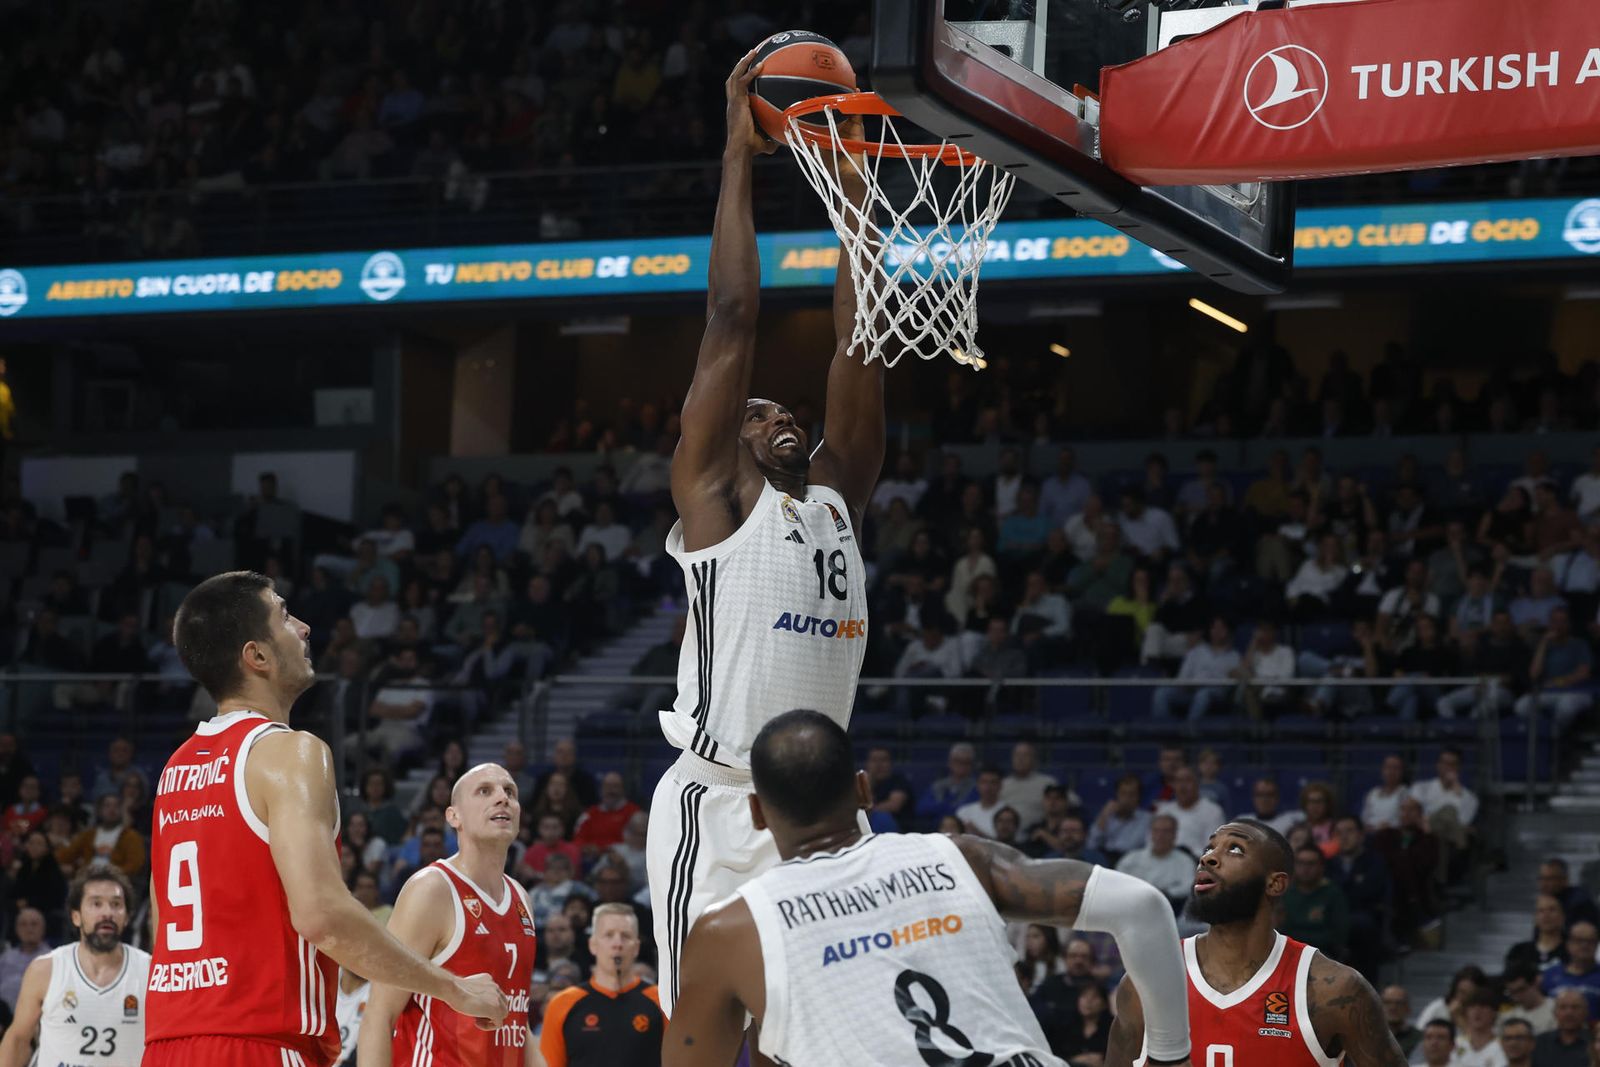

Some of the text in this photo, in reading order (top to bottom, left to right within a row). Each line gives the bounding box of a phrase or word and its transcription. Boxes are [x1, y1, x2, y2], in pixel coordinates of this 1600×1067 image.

[1351, 50, 1559, 100] TURKISH
[1013, 237, 1050, 260] DE
[1051, 234, 1130, 259] SOCIO
[1357, 223, 1427, 247] CLUB
[1429, 220, 1470, 245] DE
[1471, 217, 1540, 243] OCIO
[47, 279, 134, 300] ABIERTO
[136, 276, 172, 298] SIN
[173, 274, 241, 296] CUOTA
[243, 271, 275, 293] DE
[277, 269, 341, 291] SOCIO
[425, 263, 453, 285] TU
[455, 261, 532, 283] NUEVO
[536, 258, 594, 281] CLUB
[597, 255, 630, 278] DE
[632, 254, 690, 275] OCIO
[813, 549, 847, 600] 18
[167, 841, 203, 951] 9
[777, 863, 956, 929] RATHAN-MAYES
[504, 943, 518, 979] 7
[822, 914, 962, 967] AUTOHERO
[894, 969, 995, 1067] 8
[79, 1026, 118, 1057] 23
